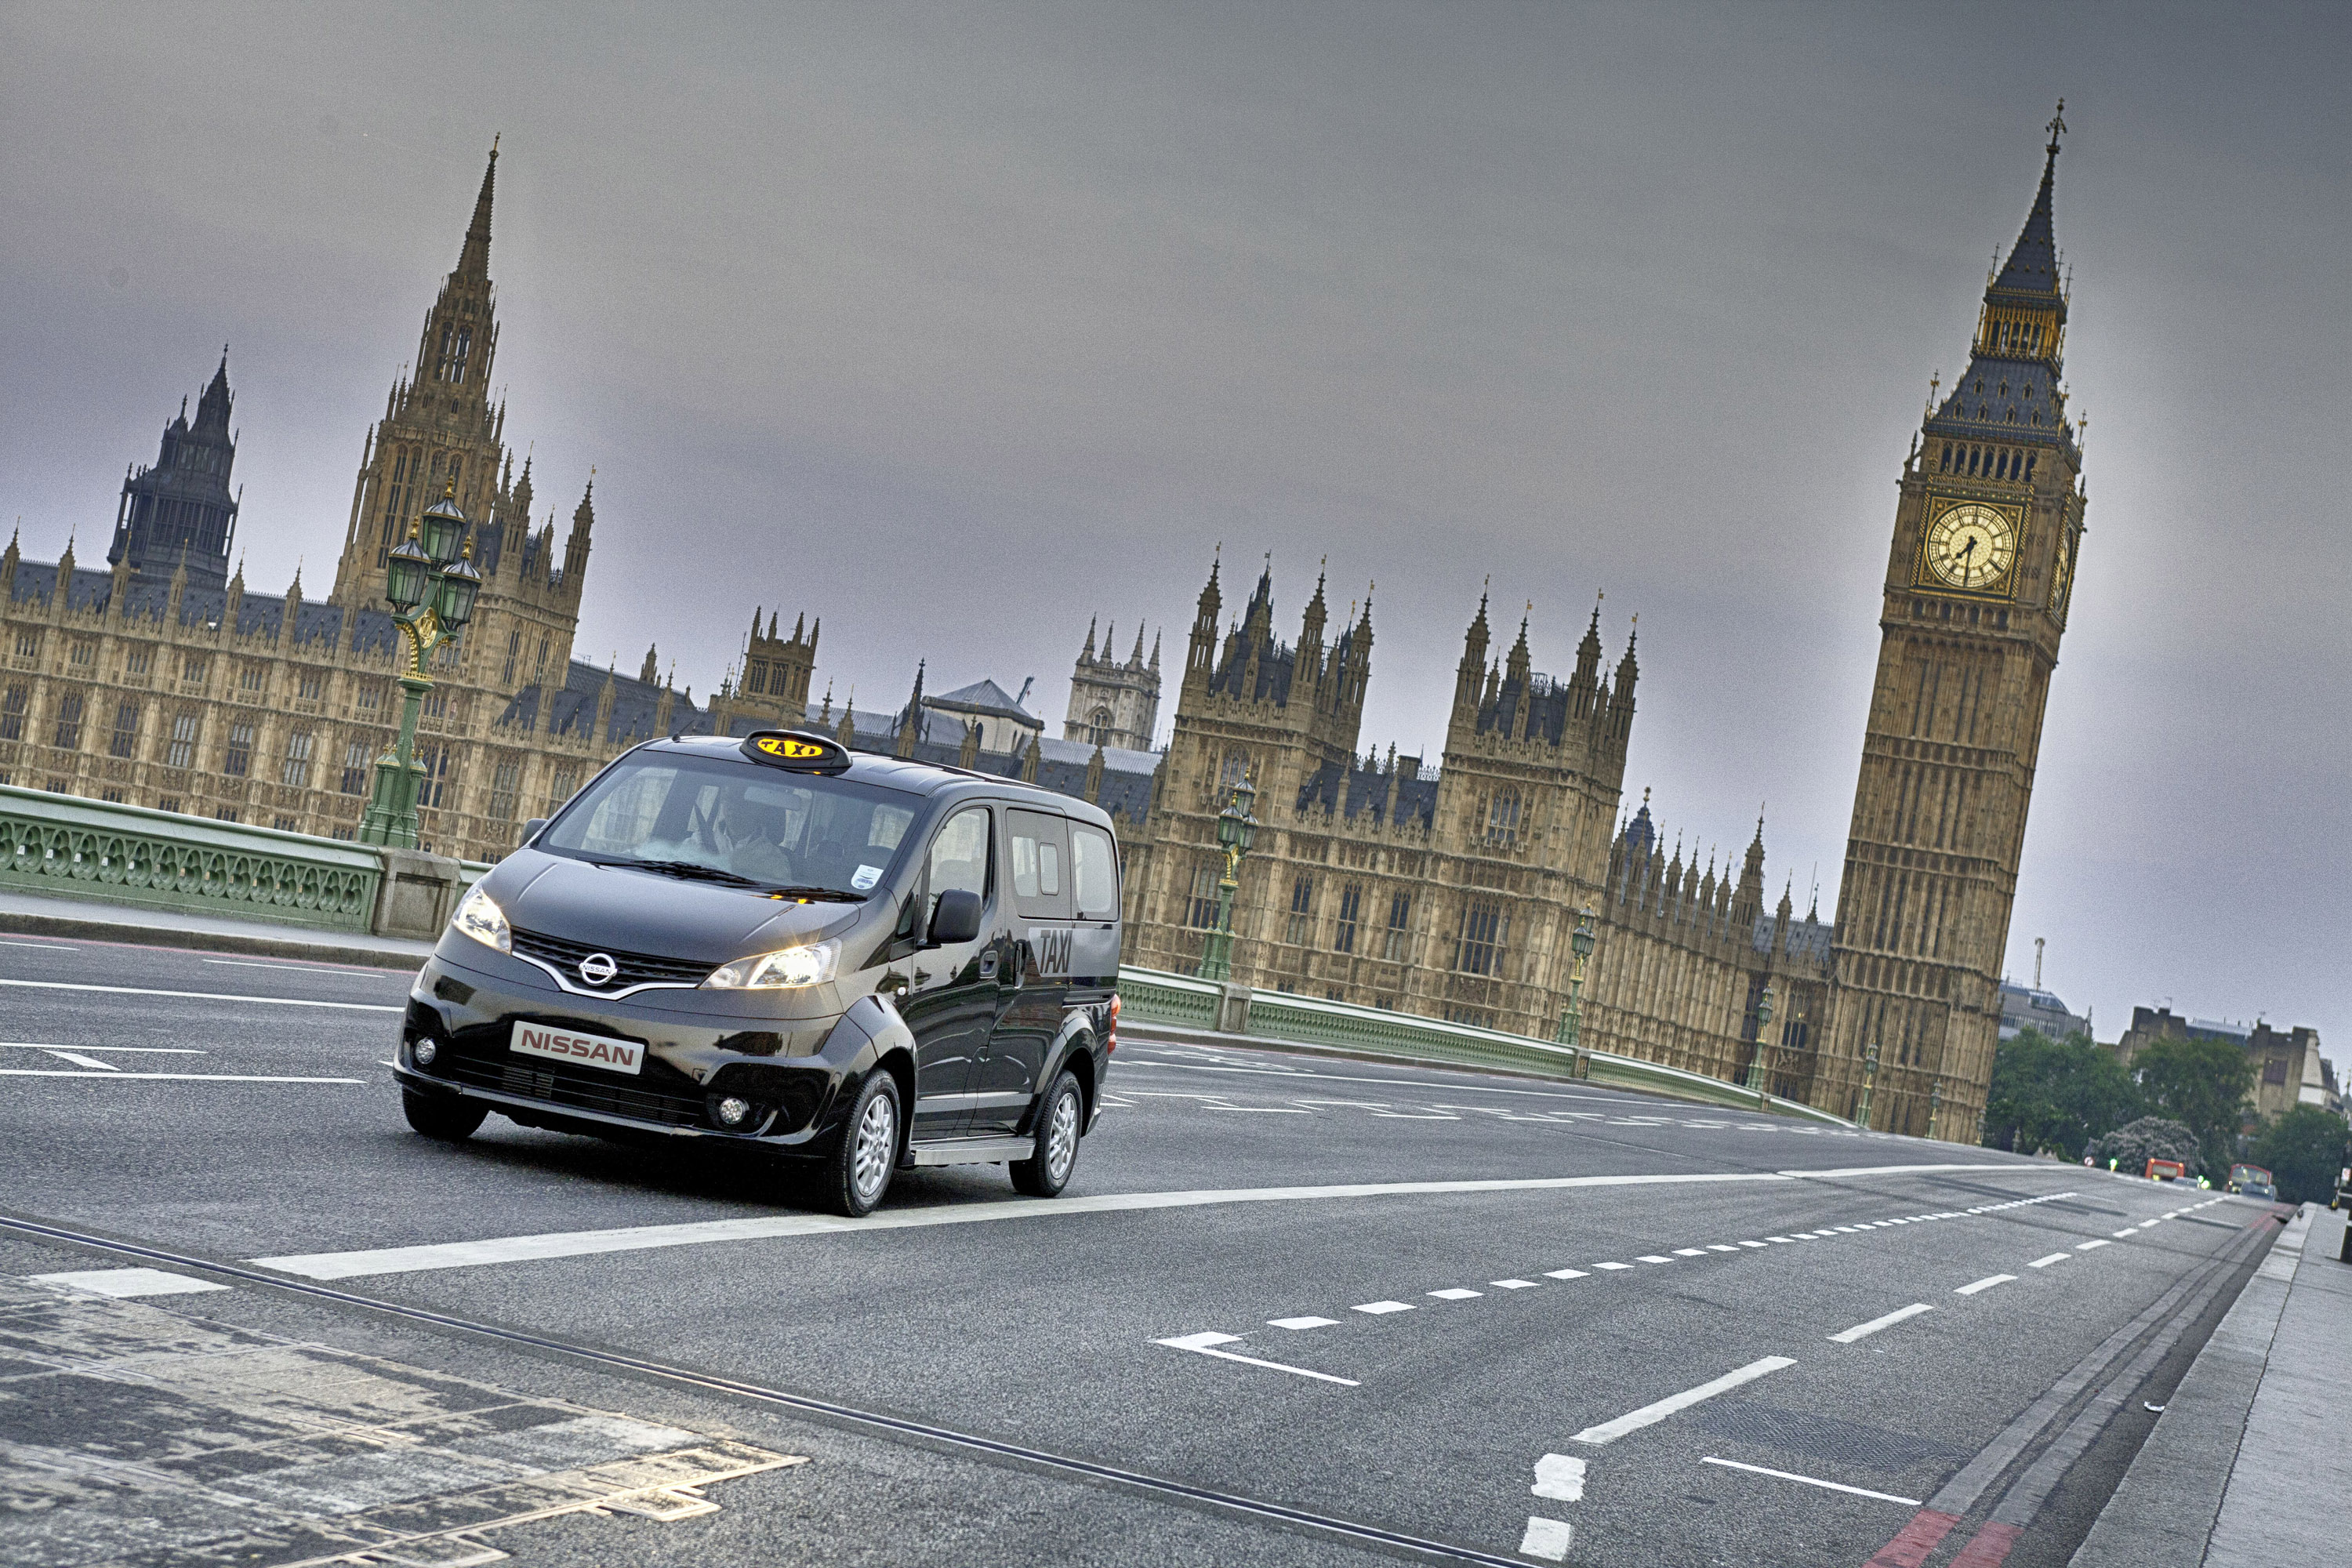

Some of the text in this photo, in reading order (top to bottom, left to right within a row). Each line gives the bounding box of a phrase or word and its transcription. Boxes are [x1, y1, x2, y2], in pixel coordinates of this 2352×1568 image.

[761, 741, 816, 755] TAXI
[1040, 930, 1073, 973] TAXI
[583, 964, 612, 974] NISSAN
[521, 1029, 633, 1066] NISSAN
